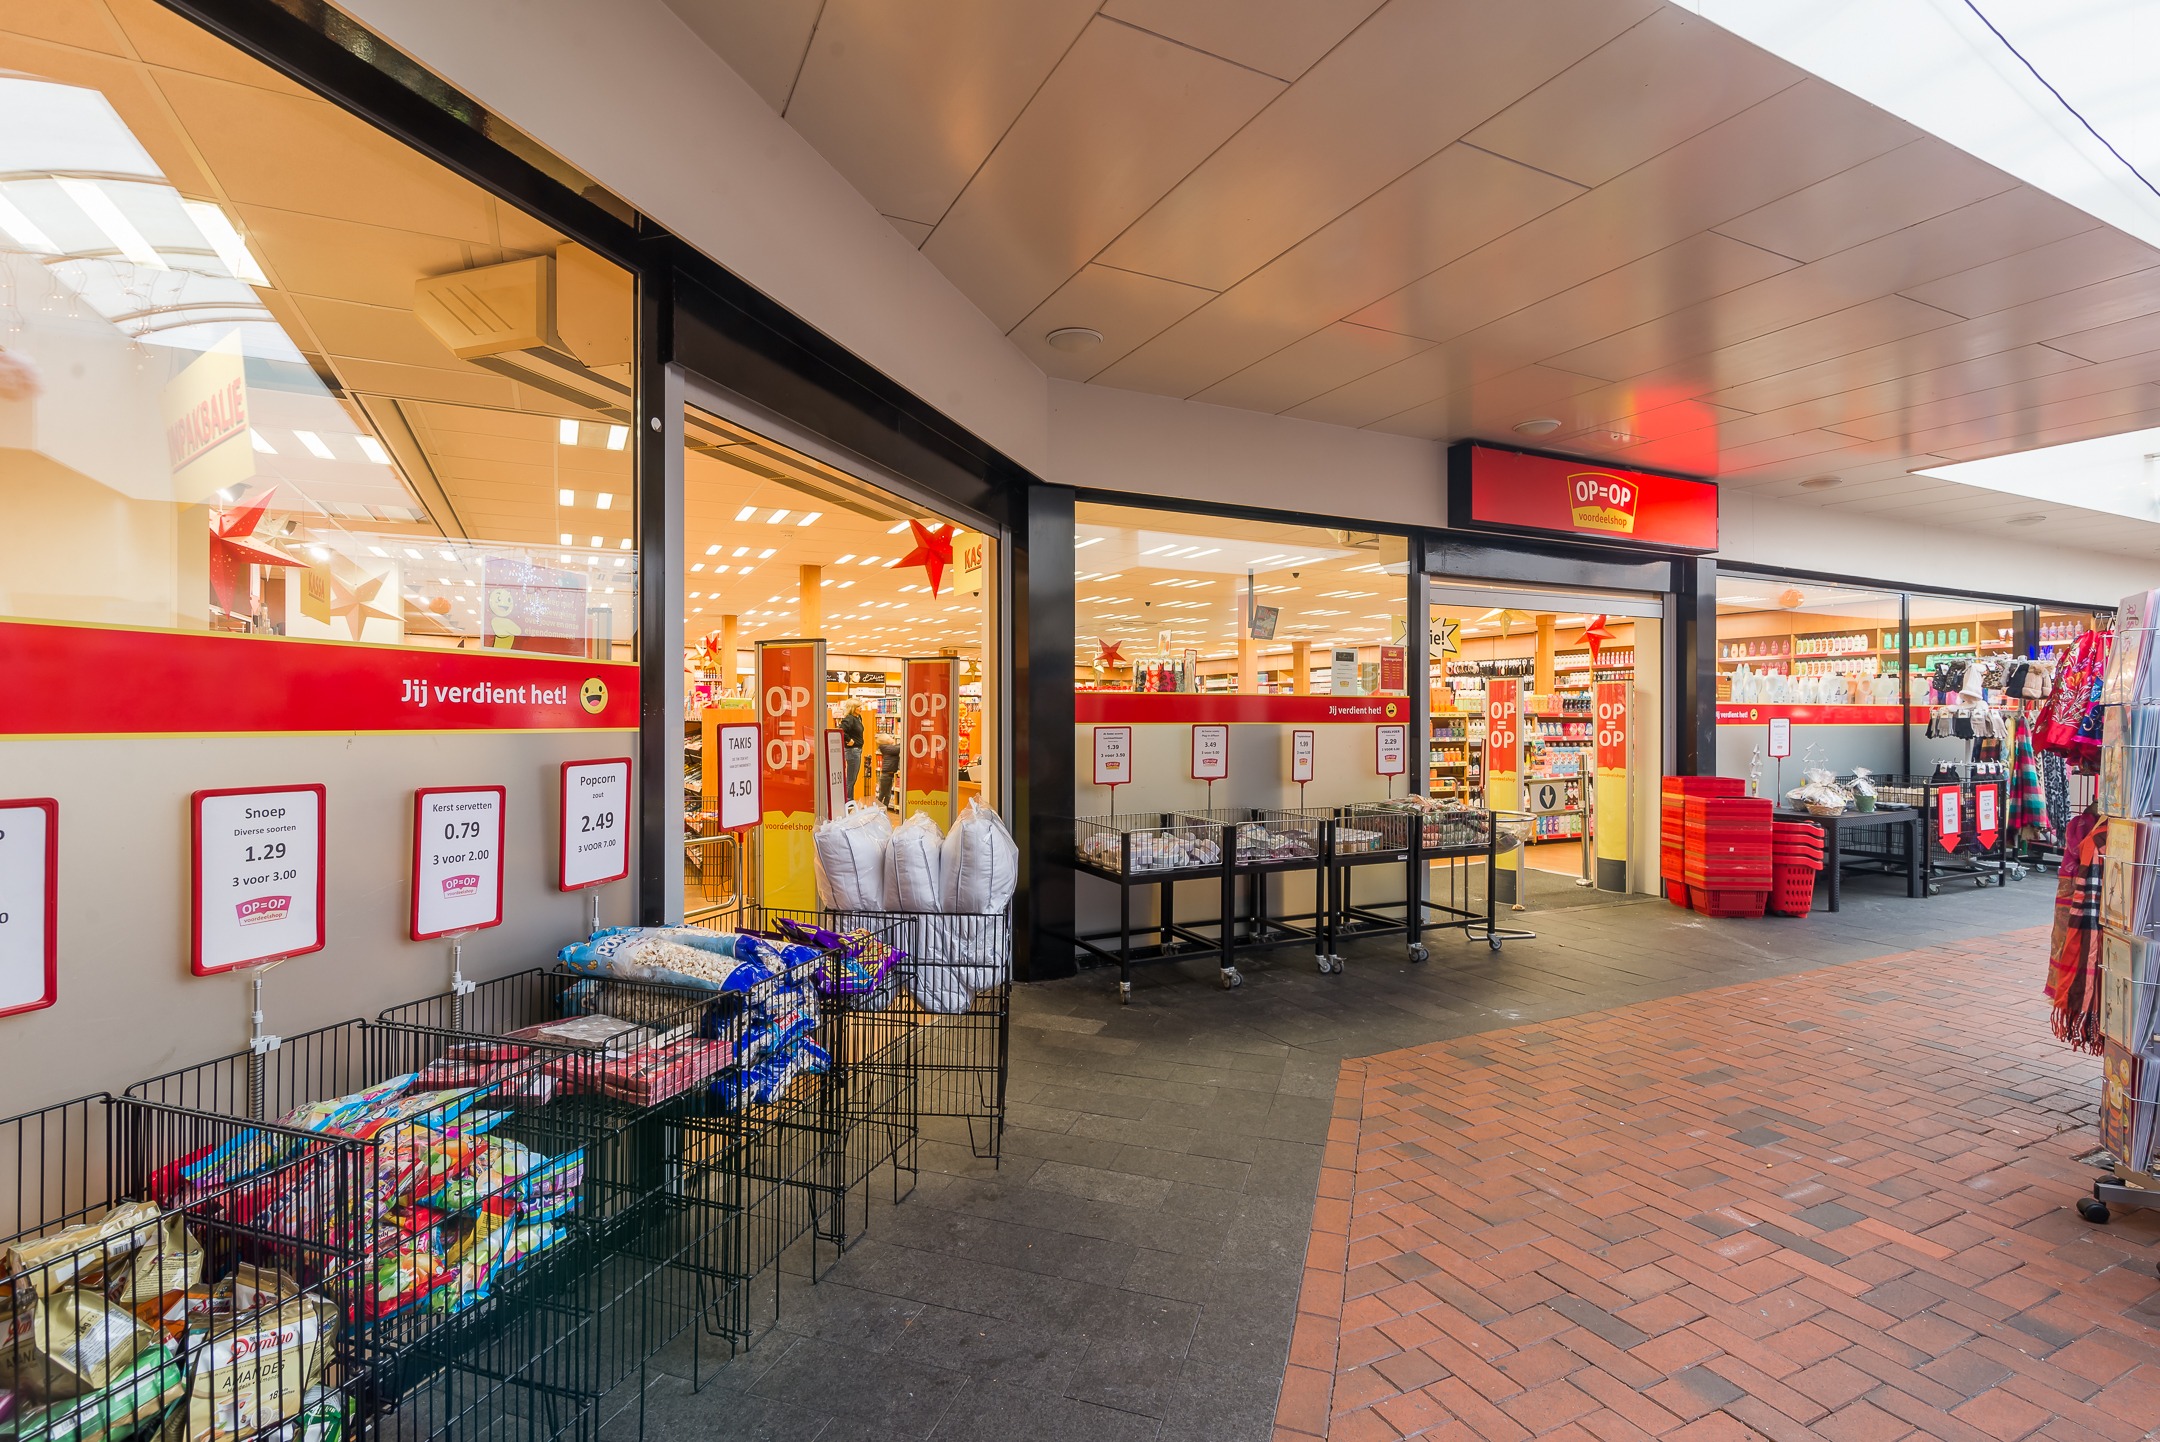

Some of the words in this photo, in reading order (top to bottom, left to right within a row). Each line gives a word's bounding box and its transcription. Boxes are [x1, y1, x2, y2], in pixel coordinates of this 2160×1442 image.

[1576, 481, 1631, 507] OP=OP
[1579, 513, 1627, 528] voordeelshop
[308, 571, 325, 599] KASSA
[402, 680, 428, 708] Jij
[434, 682, 526, 704] verdient
[531, 684, 567, 705] het!
[766, 686, 811, 717] OP
[910, 693, 947, 718] OP
[1329, 706, 1337, 716] Jij
[1338, 706, 1367, 714] verdient
[1368, 706, 1381, 715] het!
[1491, 702, 1515, 720] OP
[1599, 703, 1625, 720] OP
[729, 737, 752, 750] TAKIS
[910, 734, 947, 759] OP
[1490, 730, 1515, 749] OP
[1599, 730, 1625, 747] OP
[766, 739, 811, 771] OP
[581, 775, 616, 787] Popcorn
[729, 780, 752, 797] 4.50
[433, 804, 454, 812] Kerst
[456, 803, 492, 811] servetten
[908, 799, 948, 807] voordeelshop
[245, 808, 286, 819] Snoep
[234, 828, 265, 837] Diverse
[267, 825, 297, 833] soorten
[444, 822, 480, 840] 0.79
[581, 812, 614, 833] 2.49
[765, 822, 813, 832] voordeelshop
[246, 843, 286, 862] 1.29
[578, 845, 583, 853] 3
[584, 842, 602, 852] VOOR
[603, 839, 616, 848] 7.00
[433, 855, 439, 865] 3
[442, 854, 466, 864] voor
[468, 850, 489, 861] 2.00
[232, 877, 240, 887] 3
[243, 874, 270, 885] voor
[273, 869, 297, 881] 3.00
[446, 877, 476, 889] OP=OP
[242, 899, 286, 914] OP=OP
[244, 912, 283, 923] voordeelshop
[227, 1331, 294, 1365] Domino
